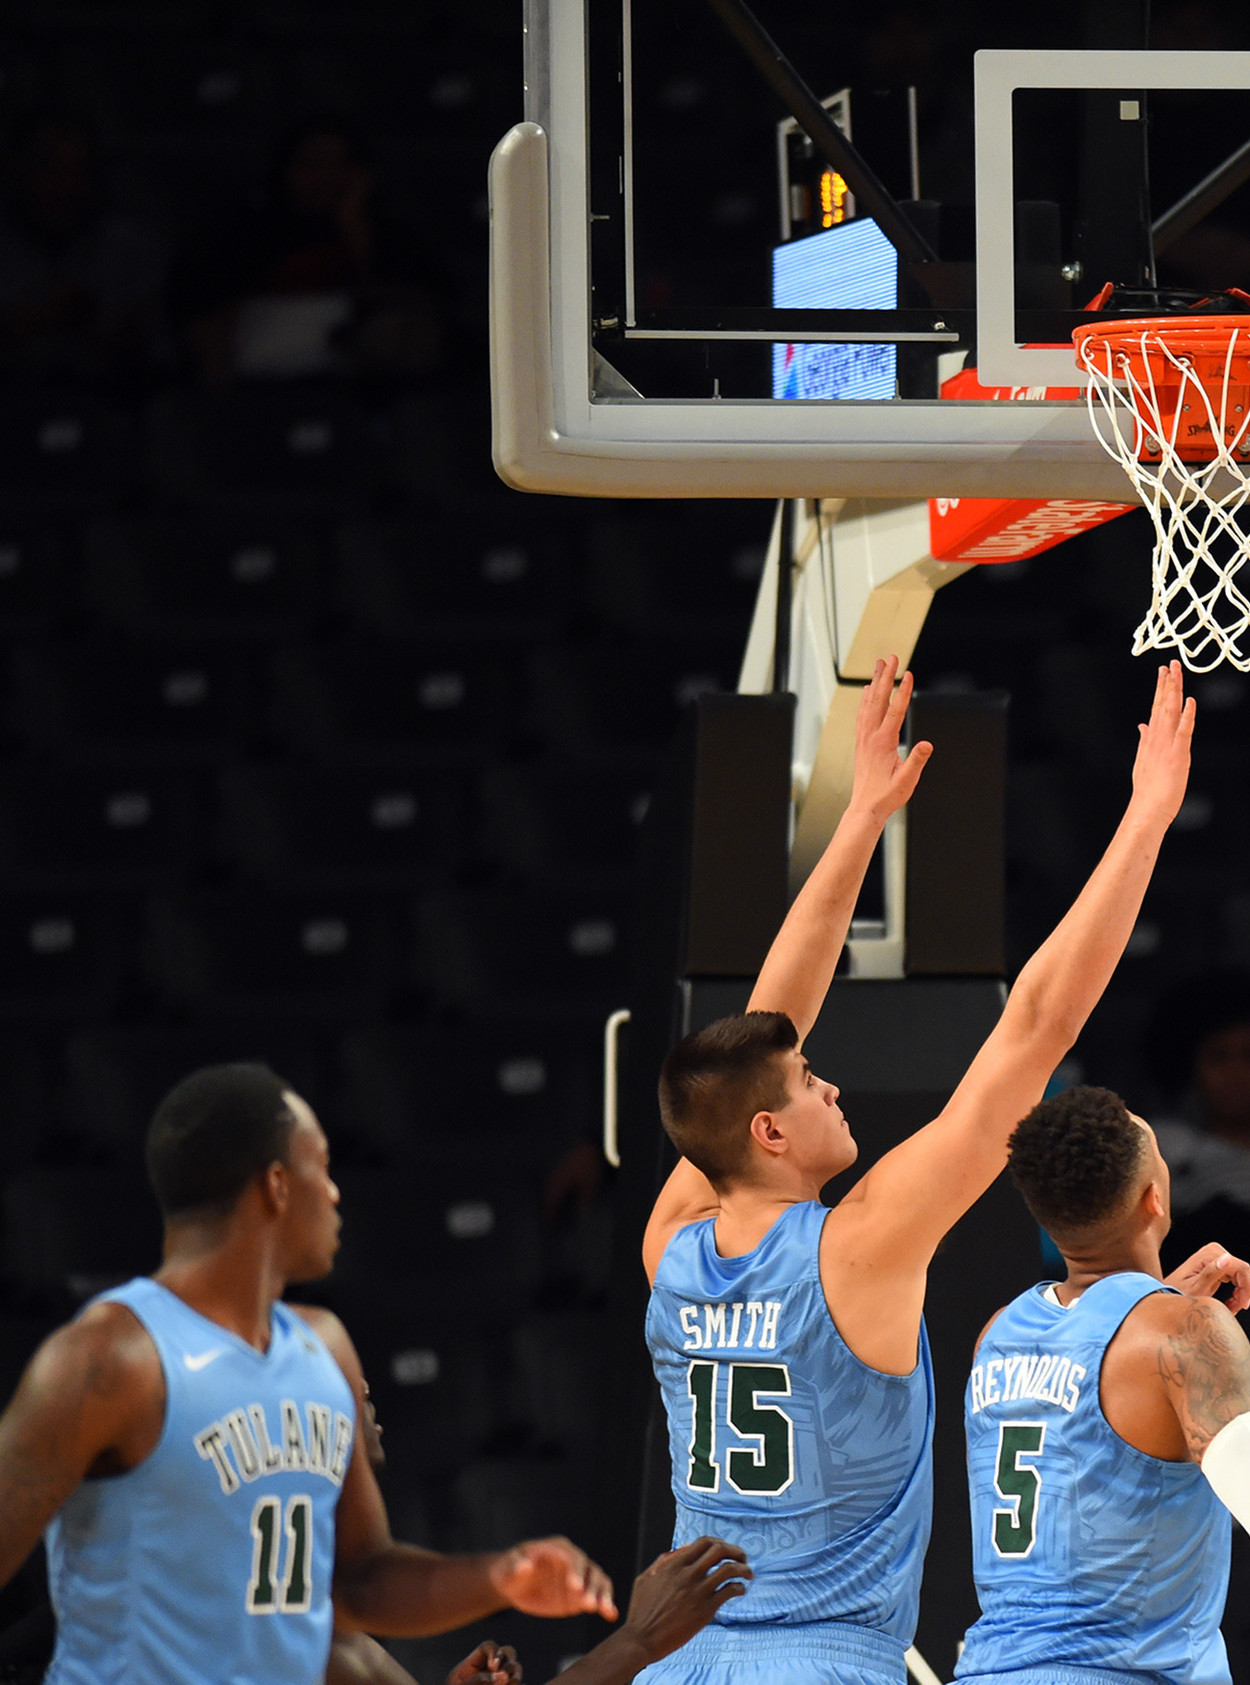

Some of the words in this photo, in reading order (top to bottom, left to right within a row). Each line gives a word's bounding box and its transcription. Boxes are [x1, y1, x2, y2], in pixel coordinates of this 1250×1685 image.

[679, 1301, 782, 1351] SMITH
[686, 1360, 795, 1497] 15
[971, 1355, 1087, 1414] REYNOLDS
[194, 1399, 354, 1496] TULANE
[991, 1421, 1048, 1558] 5
[246, 1495, 313, 1616] 11
